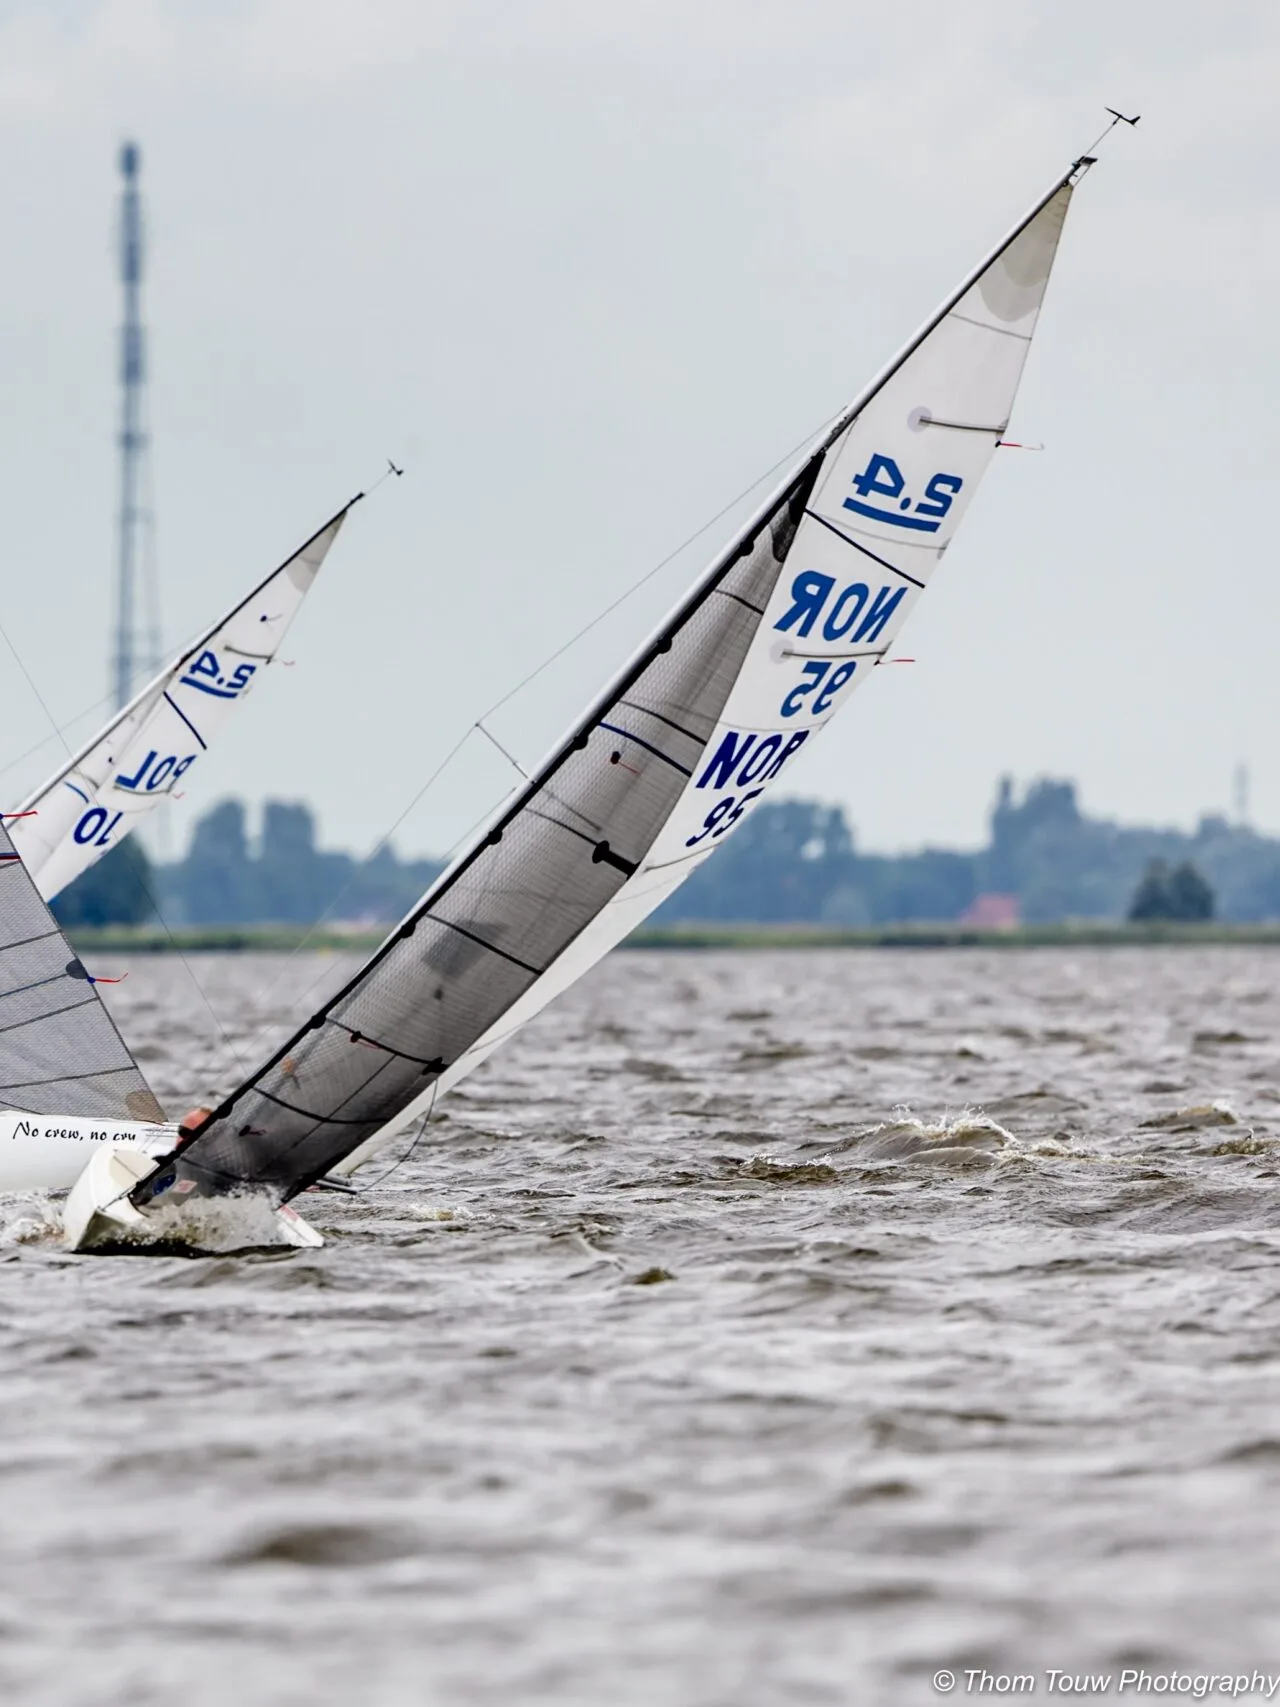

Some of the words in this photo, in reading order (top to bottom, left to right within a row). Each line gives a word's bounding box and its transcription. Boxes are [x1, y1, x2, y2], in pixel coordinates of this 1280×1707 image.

[695, 729, 810, 789] NOR
[73, 807, 124, 846] OL
[685, 787, 765, 847] 95
[12, 1121, 39, 1139] No
[44, 1128, 84, 1141] crew,
[90, 1131, 108, 1141] no
